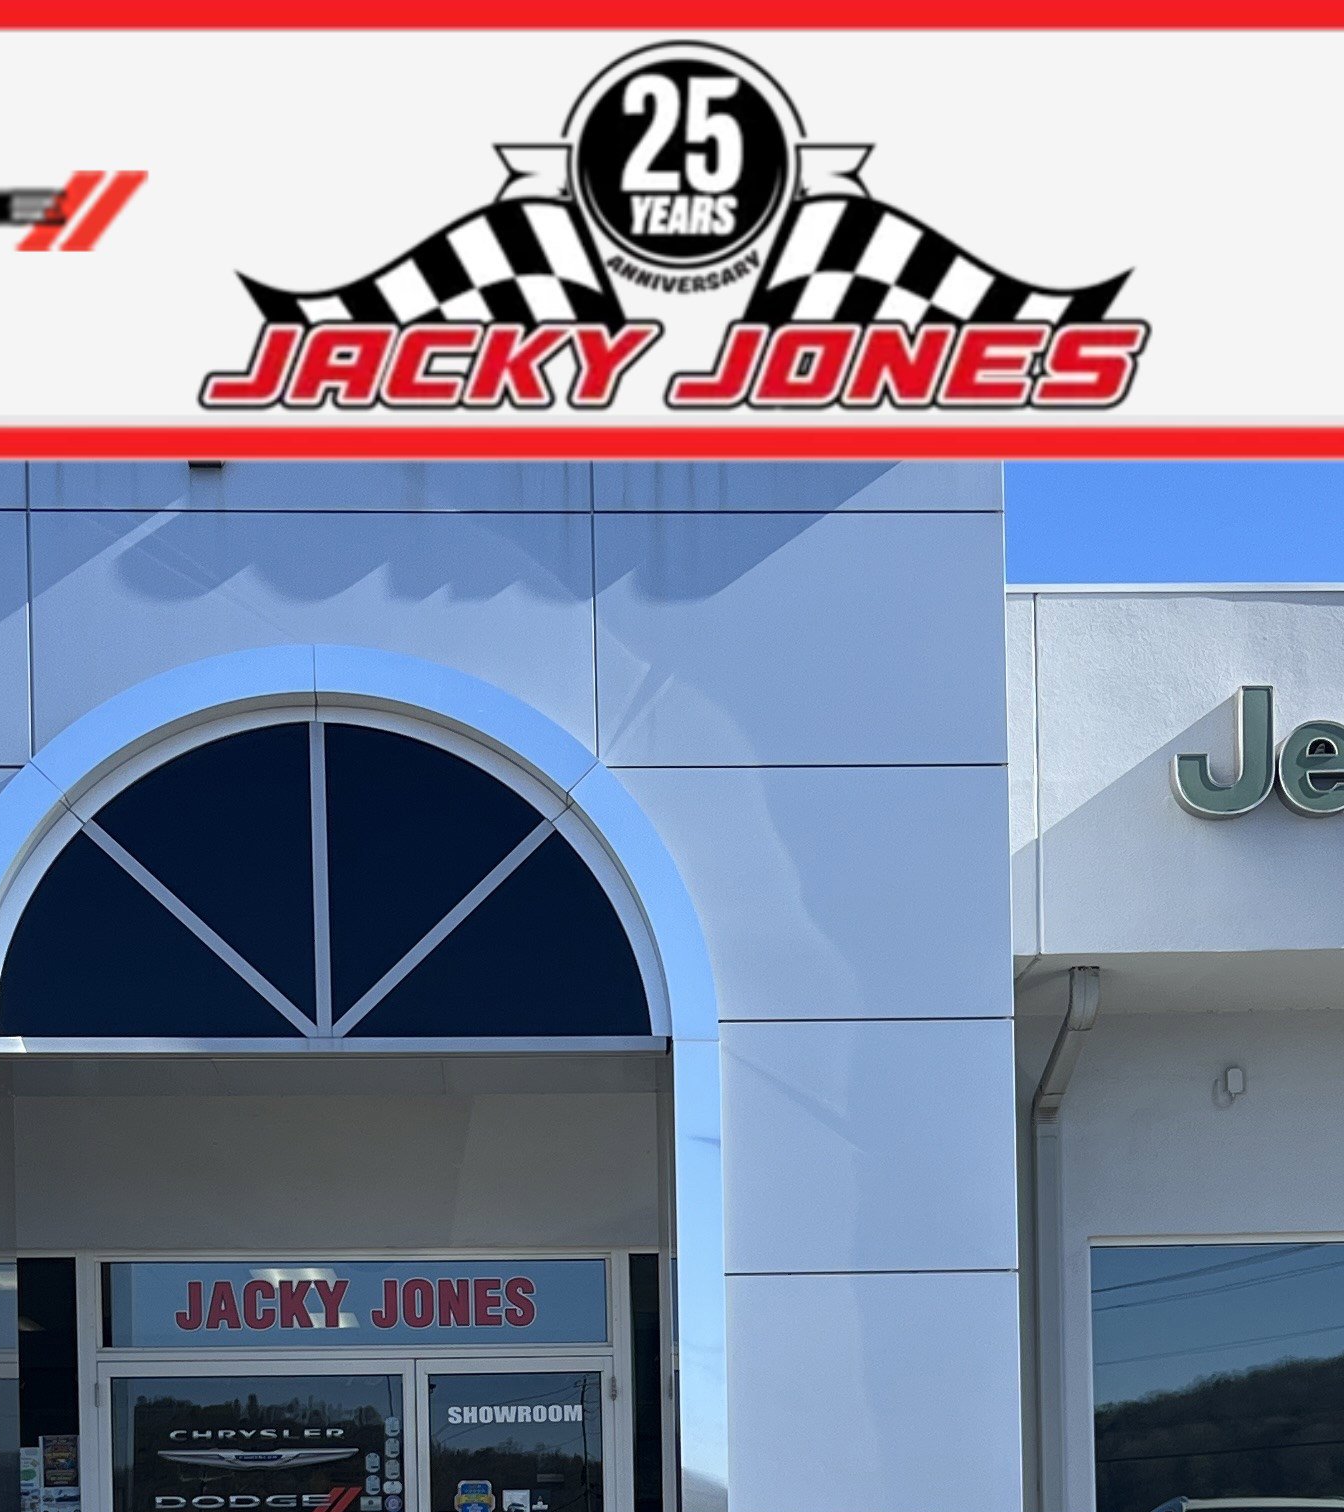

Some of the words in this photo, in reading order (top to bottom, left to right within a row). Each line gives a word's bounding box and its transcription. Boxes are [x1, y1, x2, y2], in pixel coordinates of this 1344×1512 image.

[175, 1278, 351, 1331] JACKY
[371, 1276, 537, 1329] JONES
[447, 1404, 584, 1425] SHOWROOM
[169, 1427, 346, 1441] CHRYSLER
[154, 1494, 334, 1510] DODGE
